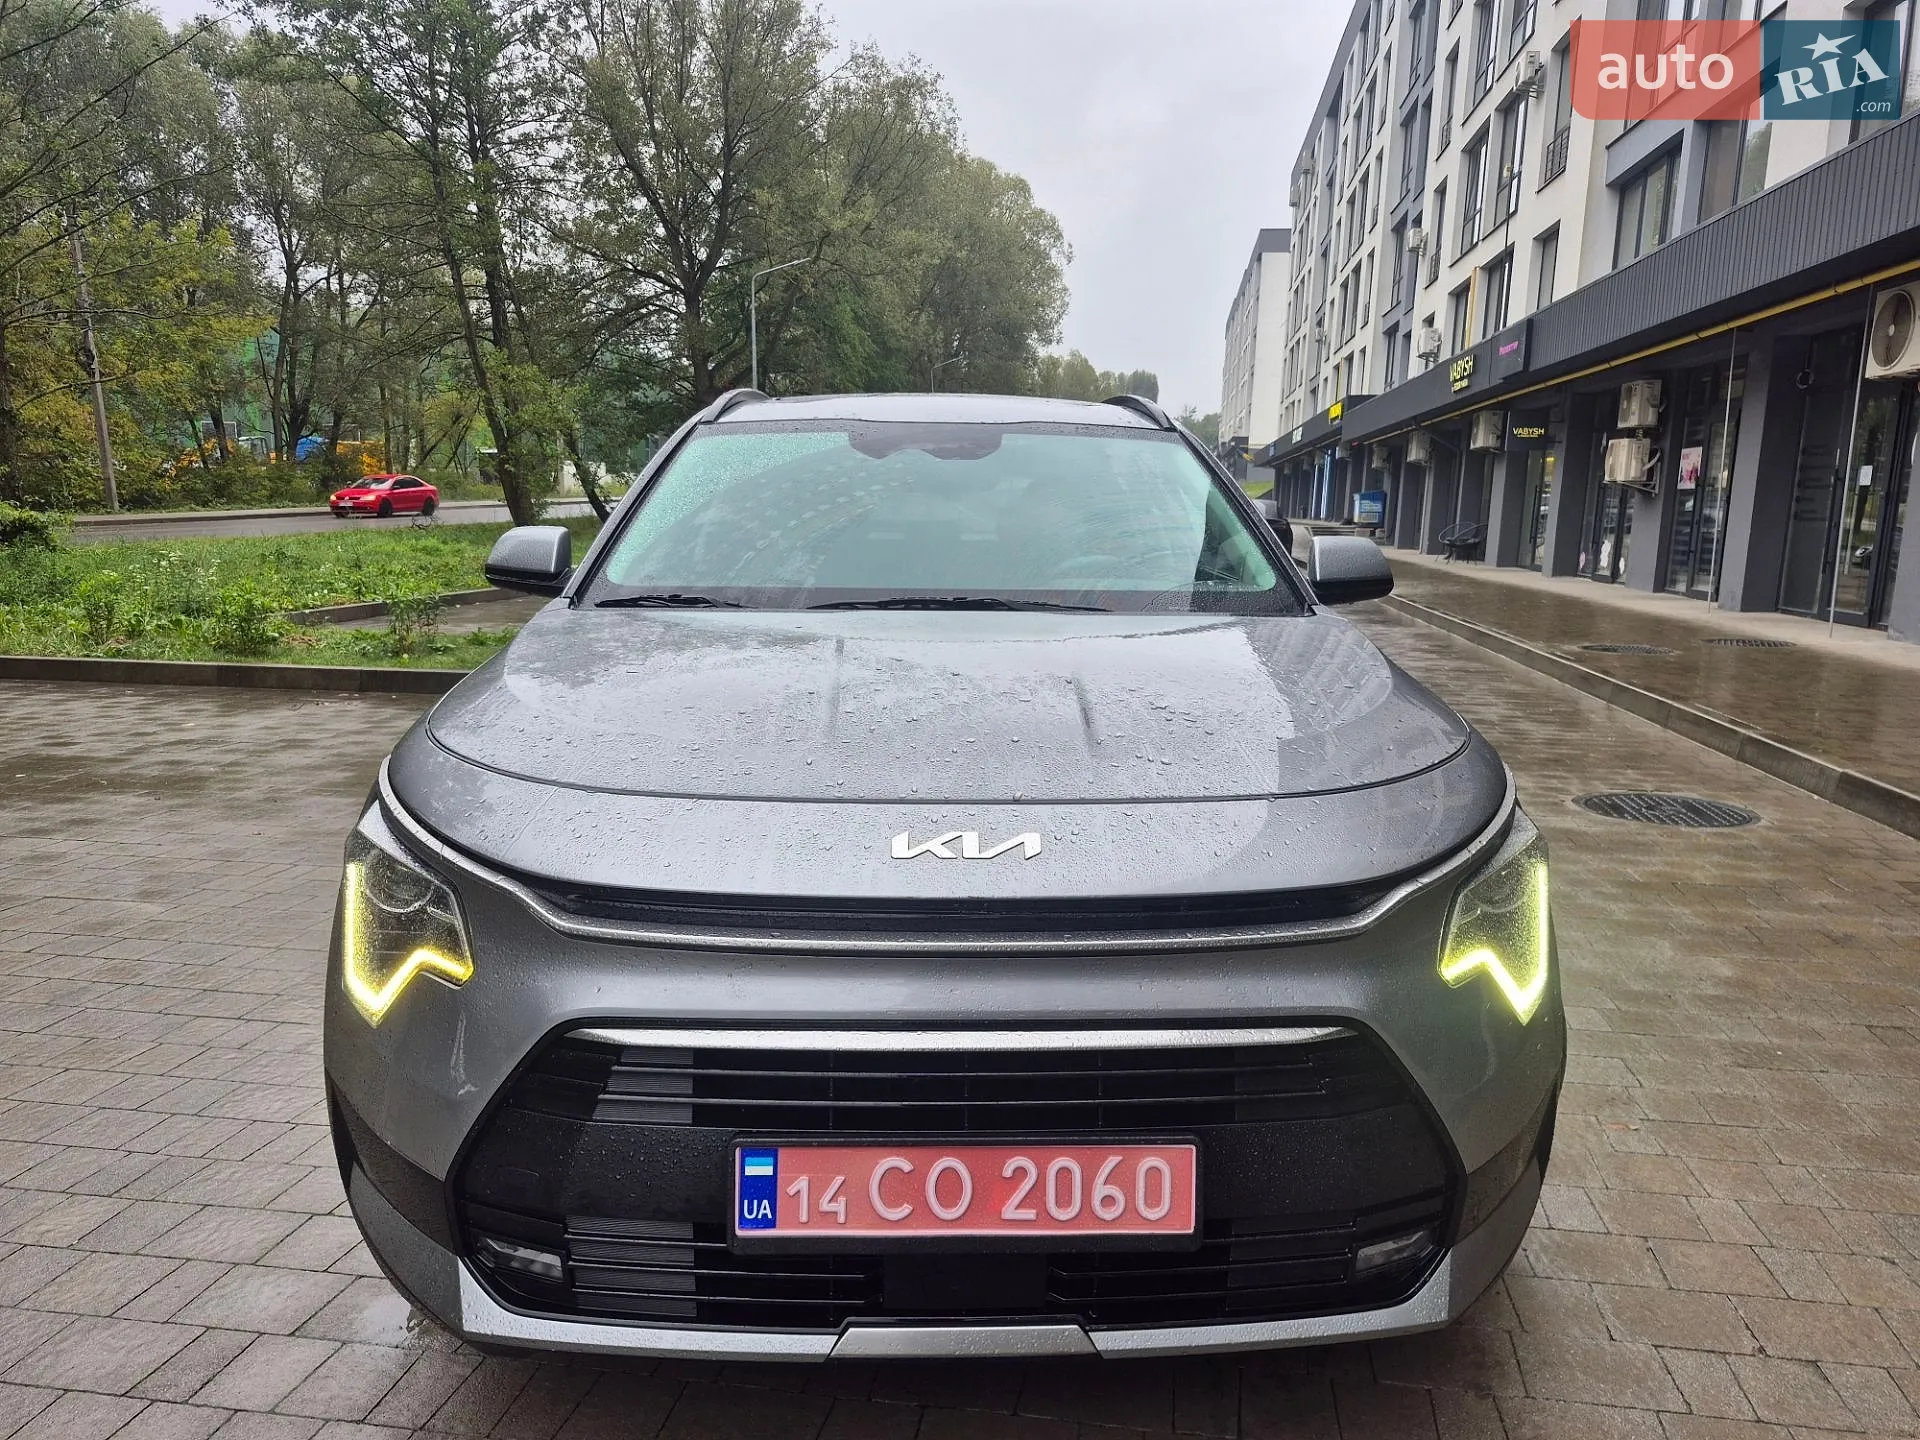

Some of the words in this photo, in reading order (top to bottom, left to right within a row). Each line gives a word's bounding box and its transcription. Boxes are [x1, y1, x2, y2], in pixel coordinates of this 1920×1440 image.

[1450, 354, 1474, 382] VABYSH
[1513, 427, 1545, 435] VABYSH
[891, 831, 1042, 860] KIA
[786, 1175, 847, 1224] 14
[868, 1157, 973, 1222] CO
[1000, 1155, 1172, 1222] 2060
[743, 1199, 772, 1219] UA
